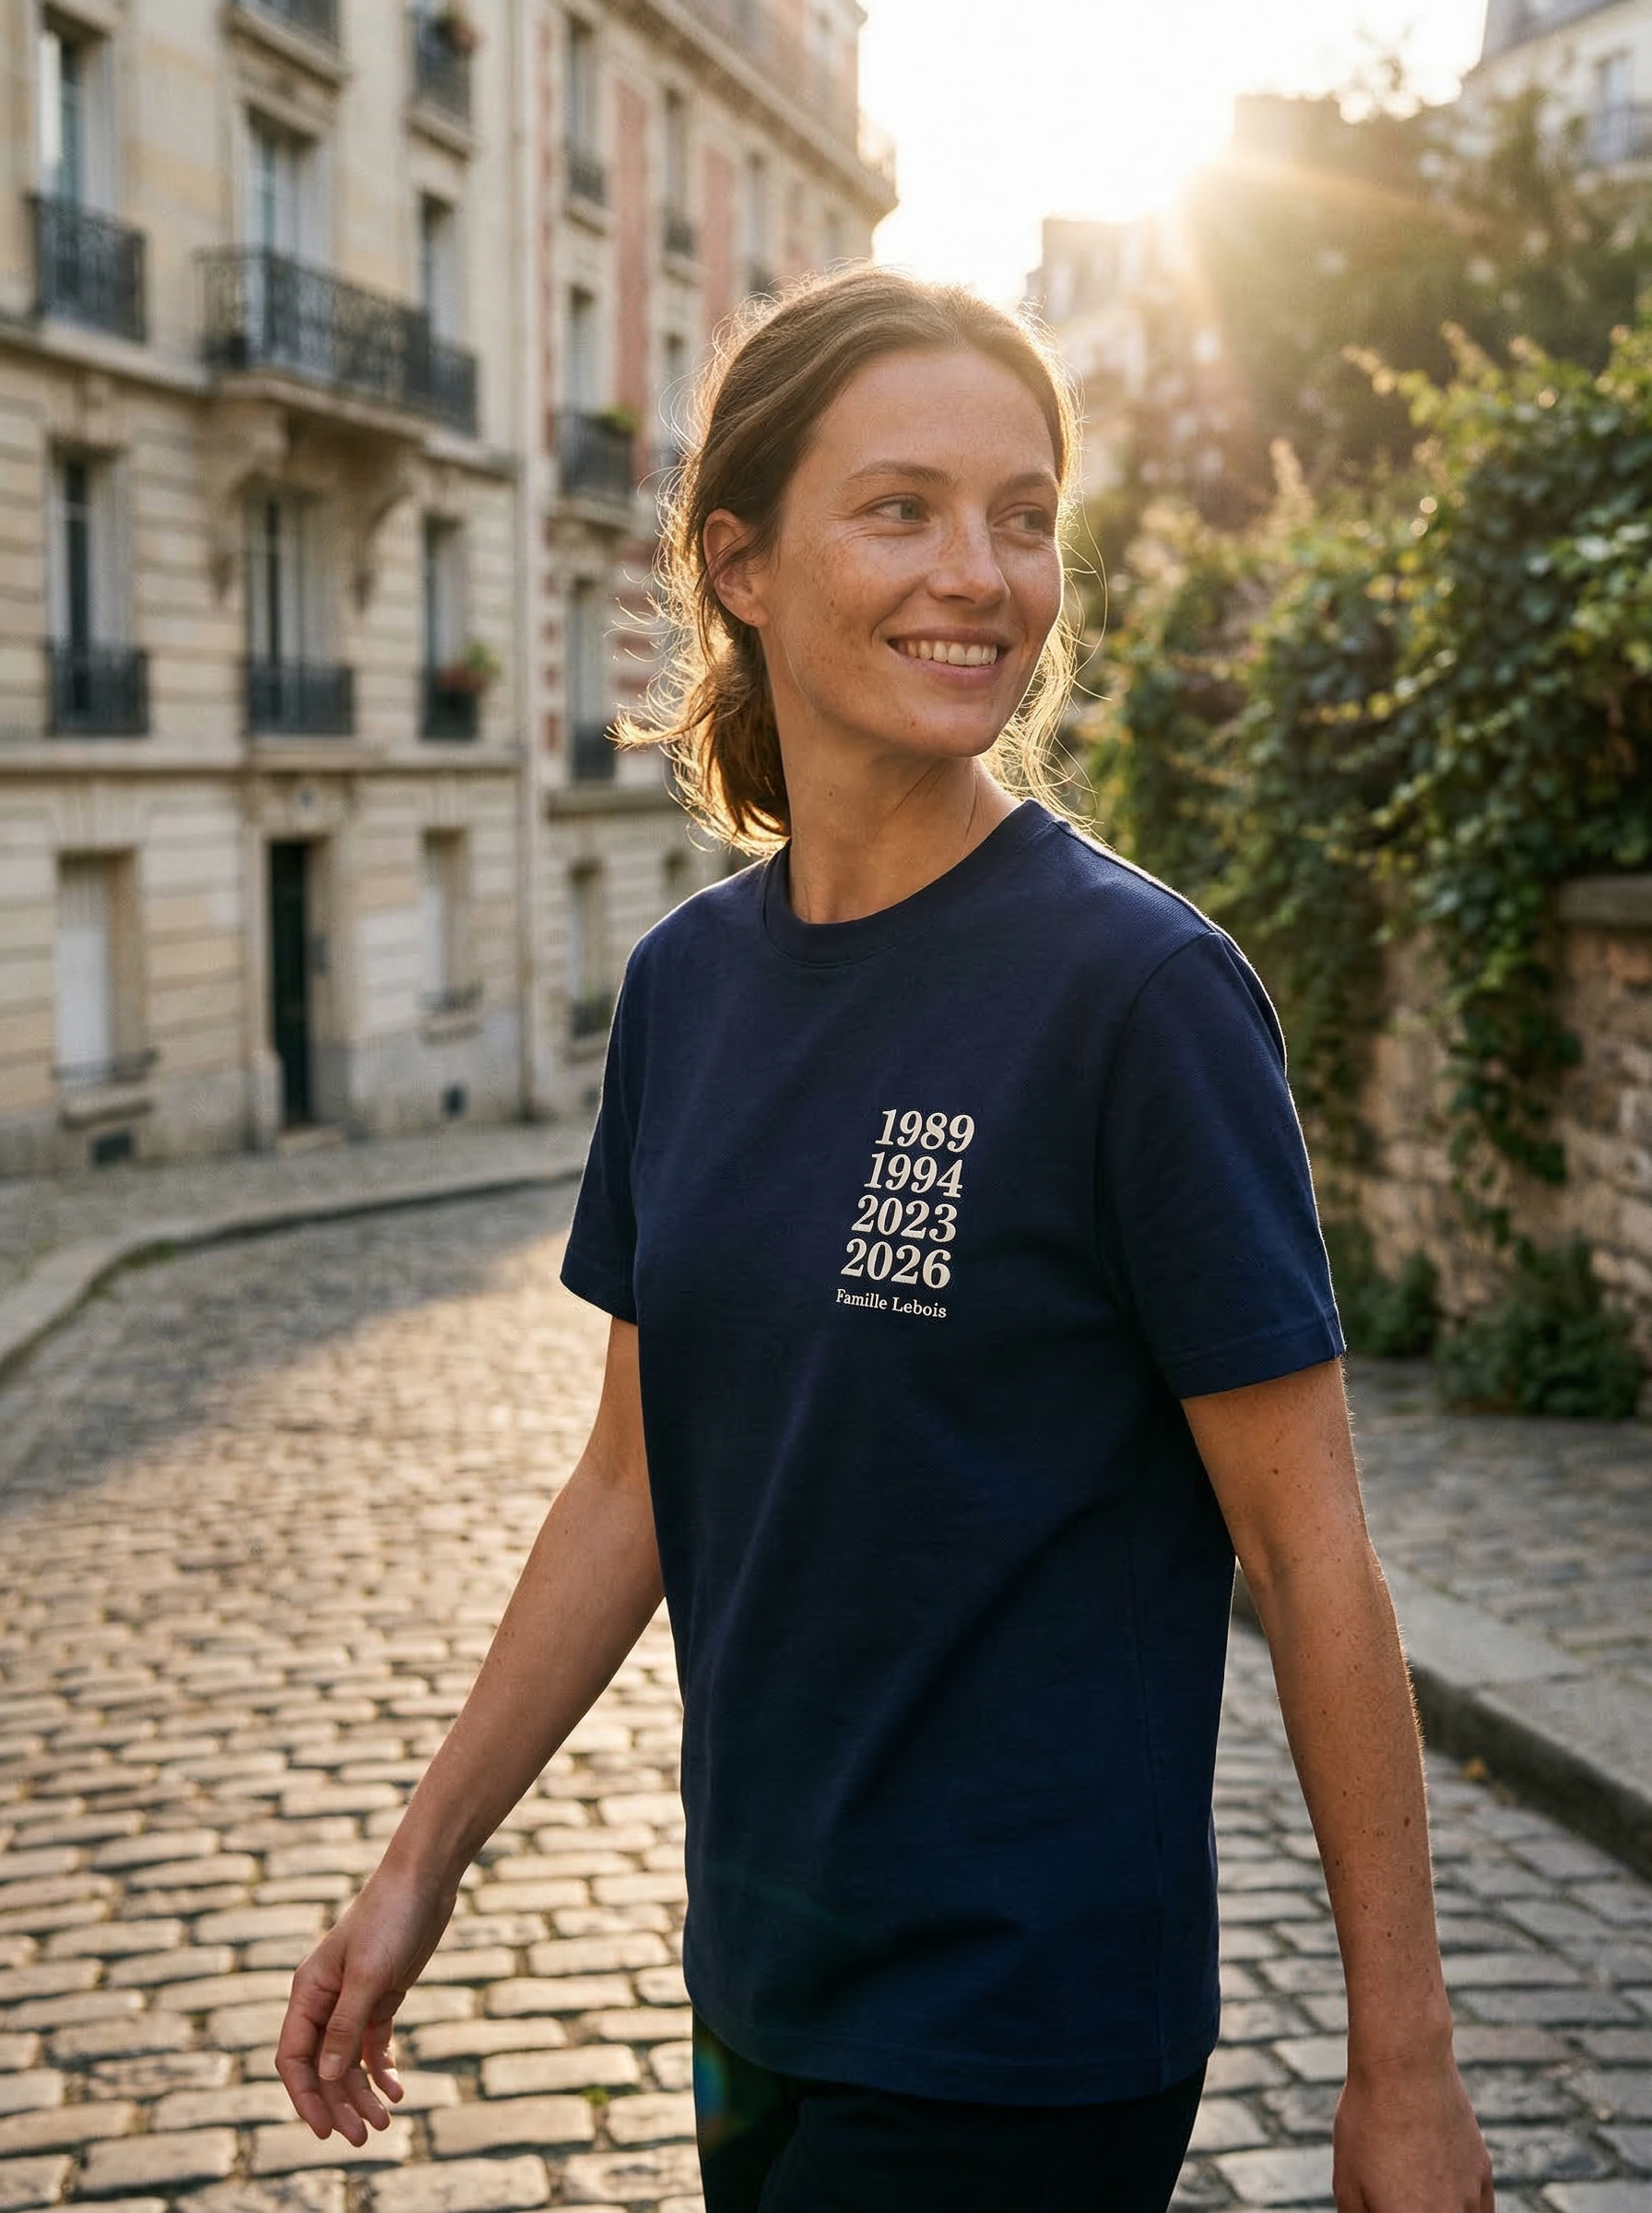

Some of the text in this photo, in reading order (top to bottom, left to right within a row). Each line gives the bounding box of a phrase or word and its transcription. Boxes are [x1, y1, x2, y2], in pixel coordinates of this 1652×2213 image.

[875, 1108, 975, 1154] 1989
[864, 1151, 963, 1198] 1994
[851, 1194, 958, 1243] 2023
[840, 1238, 951, 1289] 2026
[836, 1289, 947, 1319] Famille Lebois
